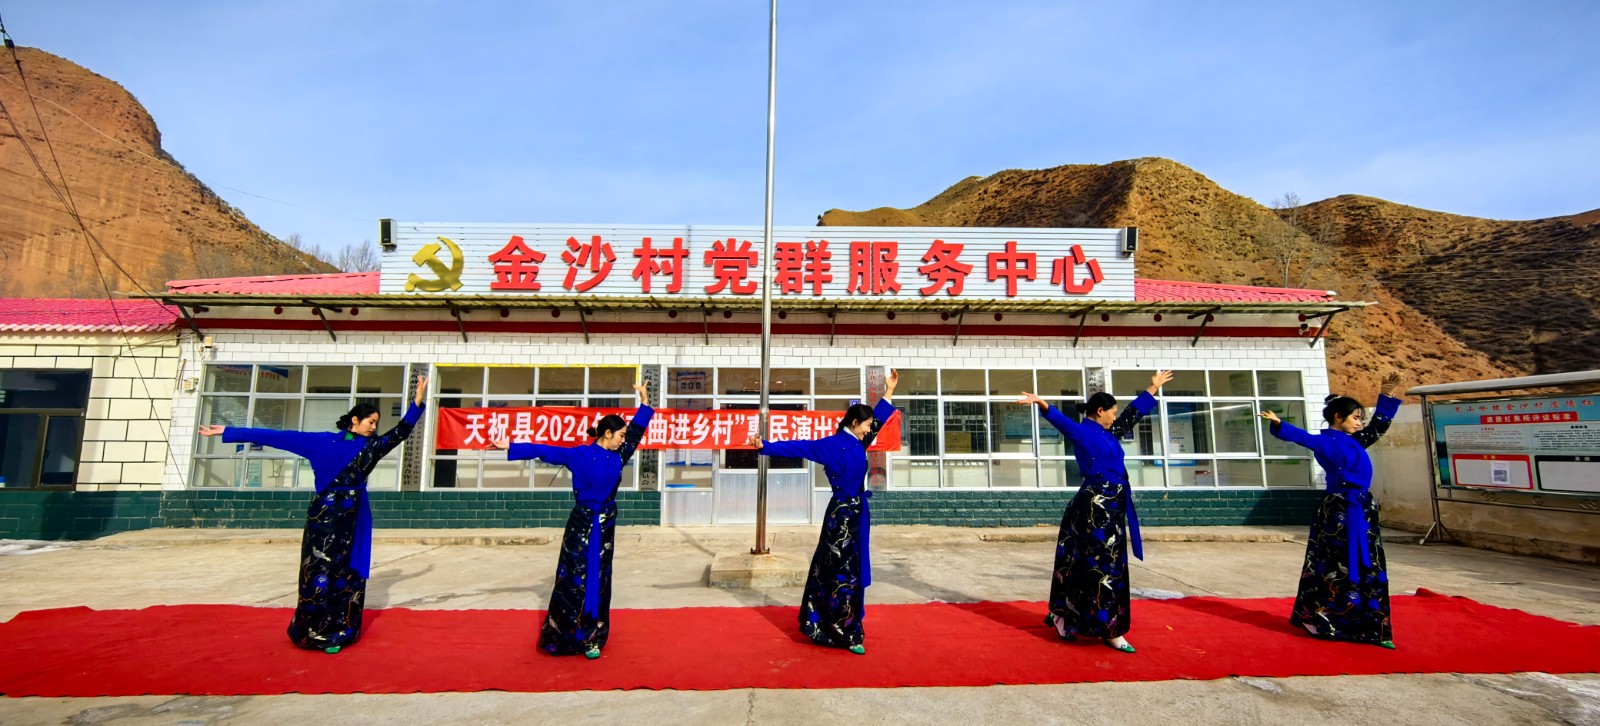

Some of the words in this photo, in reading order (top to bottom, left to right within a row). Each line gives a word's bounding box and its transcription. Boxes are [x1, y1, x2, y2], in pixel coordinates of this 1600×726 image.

[487, 234, 1105, 297] 金沙村党群服务中心
[464, 411, 877, 448] 天祝县2024“曲进乡村”惠民演出
